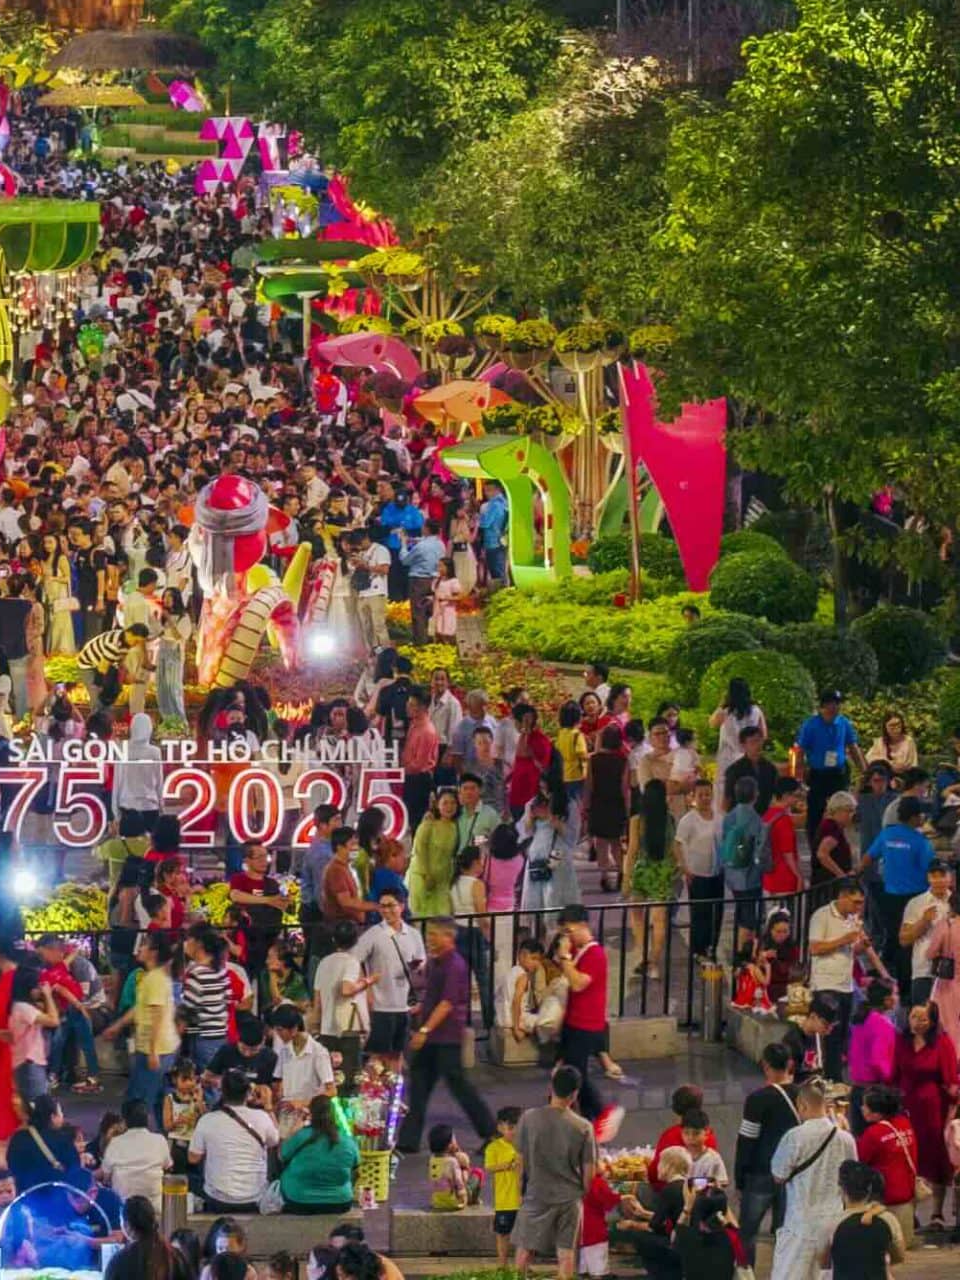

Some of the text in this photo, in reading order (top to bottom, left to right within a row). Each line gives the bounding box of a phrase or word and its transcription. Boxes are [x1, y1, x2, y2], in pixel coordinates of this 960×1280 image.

[8, 731, 399, 763] SÀI GÒN TP HỒ CHÍ MINH
[162, 768, 408, 848] 2025
